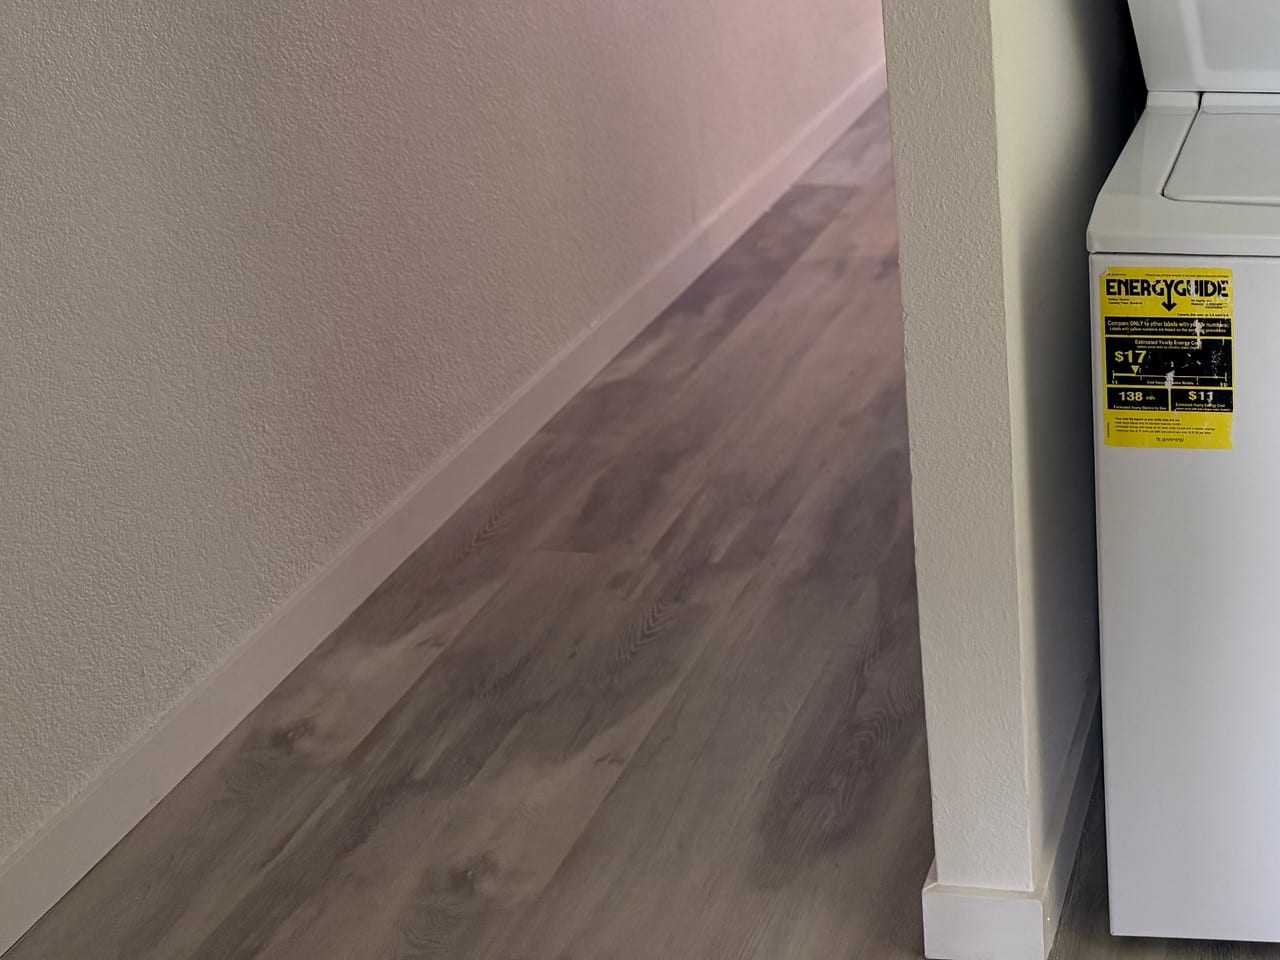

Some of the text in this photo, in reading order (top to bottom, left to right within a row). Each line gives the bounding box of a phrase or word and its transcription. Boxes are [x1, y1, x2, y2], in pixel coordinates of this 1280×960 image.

[1106, 278, 1229, 298] ENERGYGUIDE
[1114, 350, 1147, 363] $17
[1118, 391, 1143, 401] 138
[1188, 390, 1214, 401] $11
